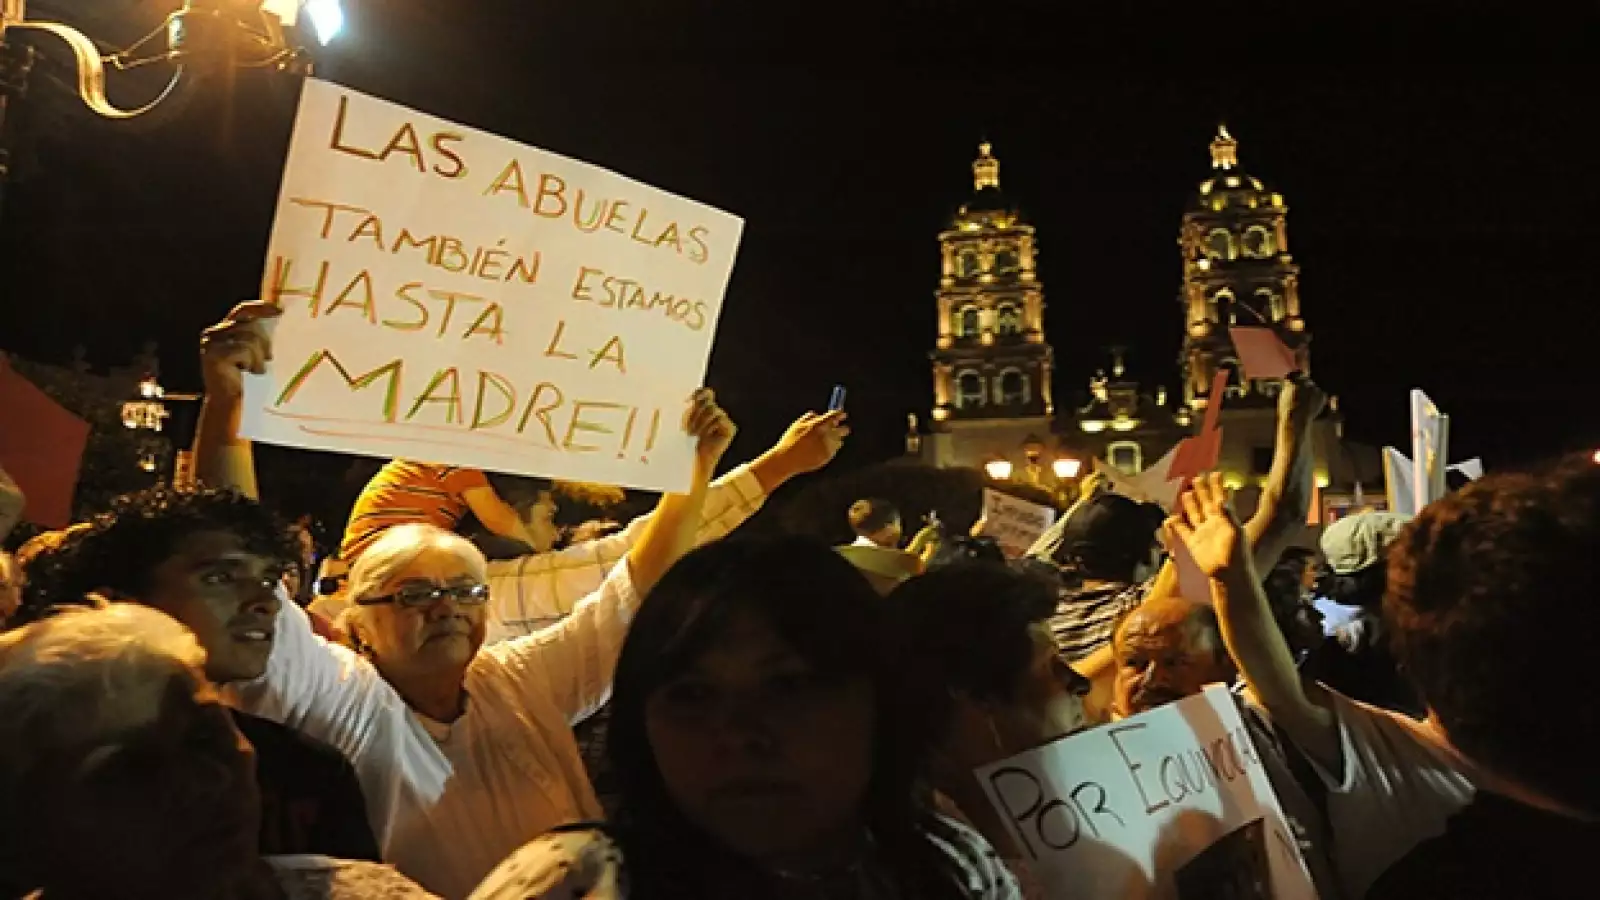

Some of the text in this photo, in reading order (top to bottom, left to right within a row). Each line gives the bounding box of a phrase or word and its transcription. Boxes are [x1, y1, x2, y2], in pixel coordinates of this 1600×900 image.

[329, 95, 710, 264] LAS ABUELAS
[269, 255, 628, 376] HASTA LA
[289, 196, 710, 332] TAMBIÉN ESTAMOS
[274, 348, 662, 464] MADRE!!
[988, 766, 1127, 862] POR
